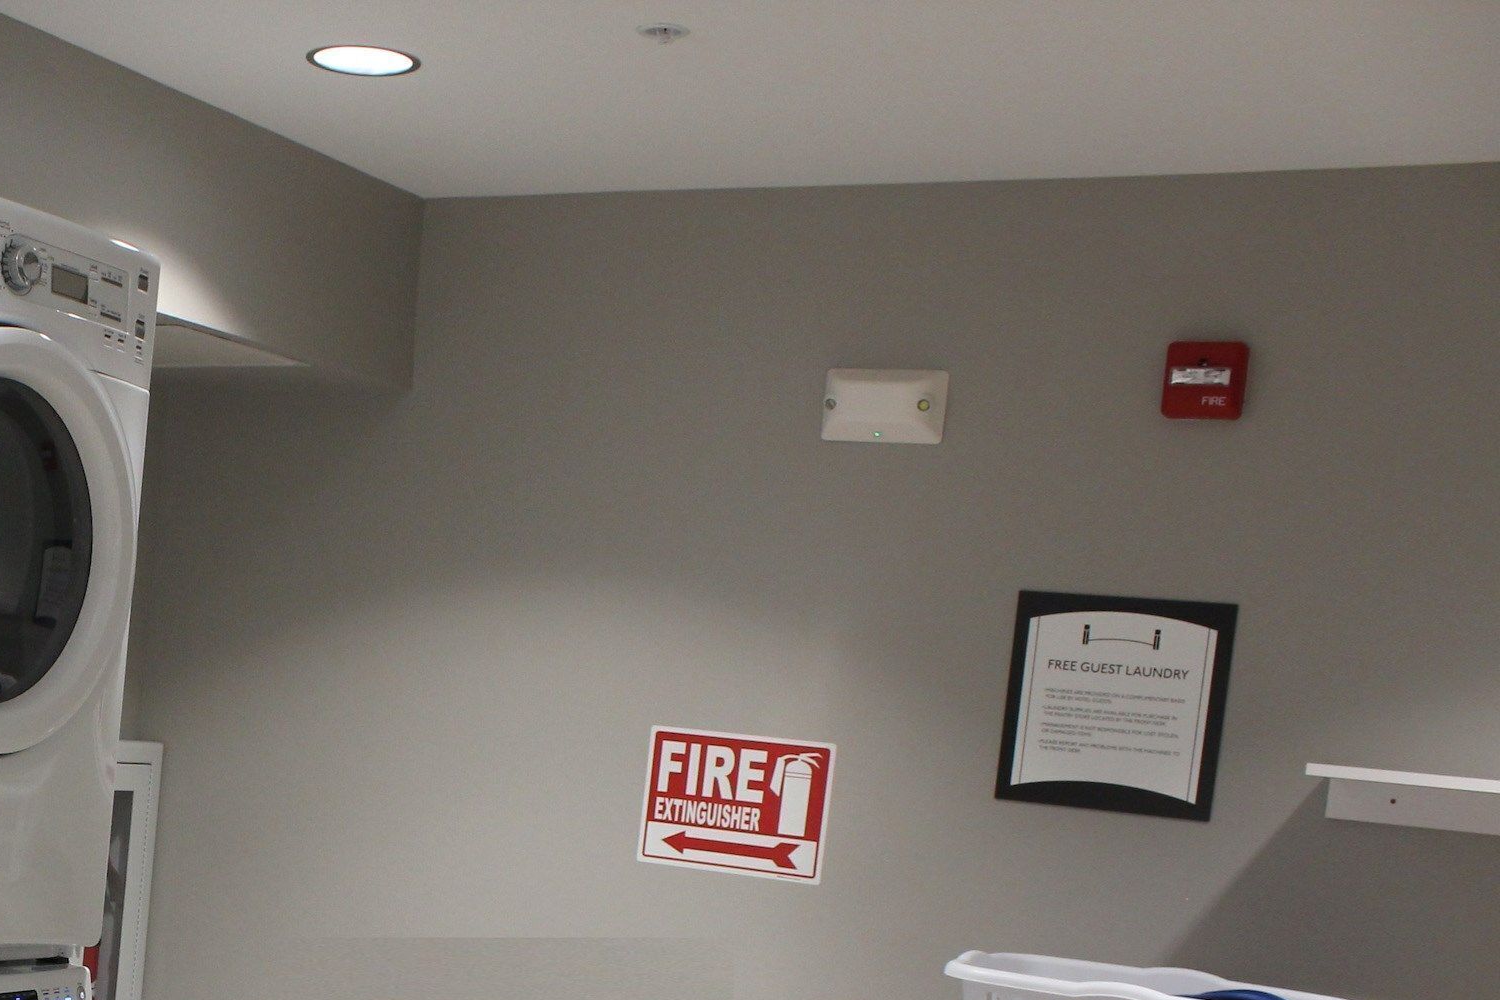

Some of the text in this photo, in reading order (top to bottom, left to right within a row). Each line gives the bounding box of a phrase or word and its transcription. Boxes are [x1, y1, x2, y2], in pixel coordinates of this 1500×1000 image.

[1201, 396, 1227, 406] FIRE
[1047, 659, 1189, 680] FREE GUEST LAUNDRY
[657, 739, 768, 804] FIRE
[653, 796, 761, 832] EXTINGUISHER
